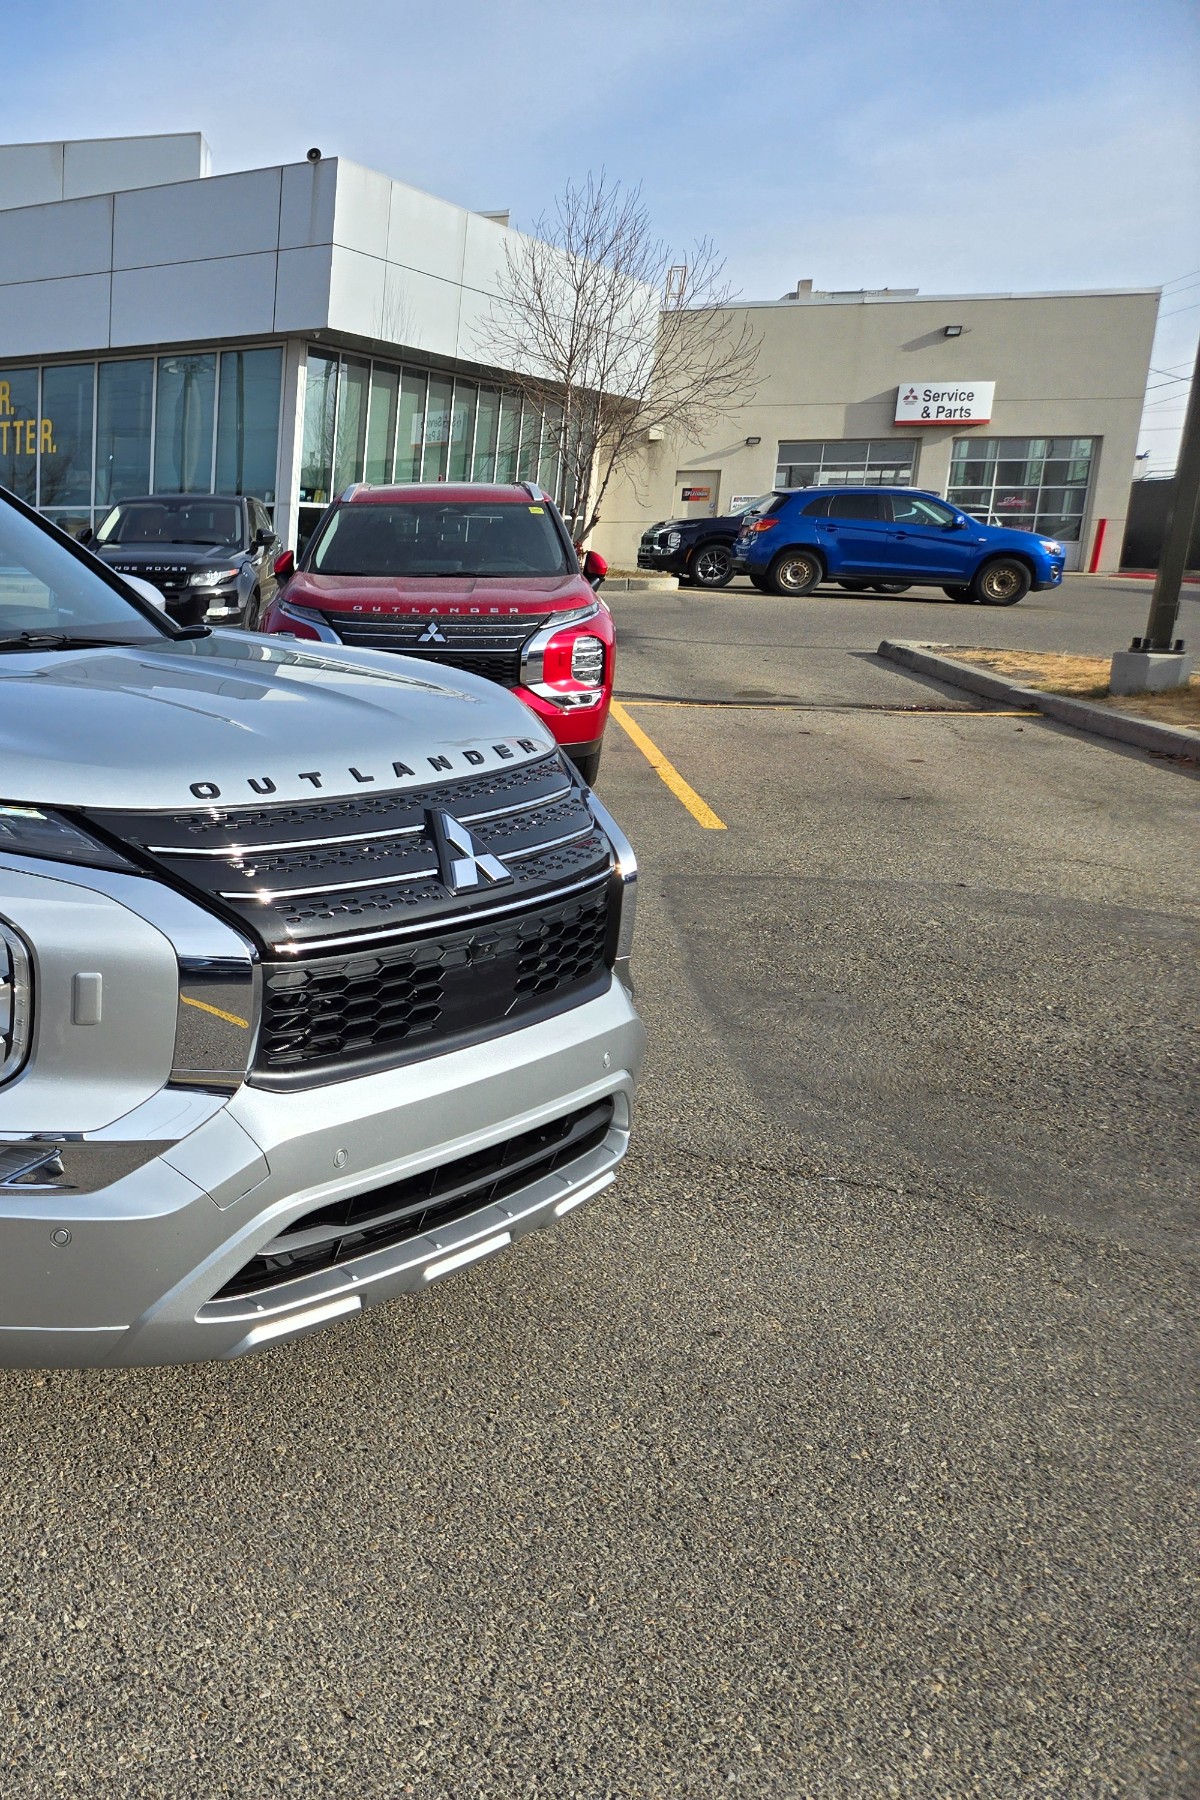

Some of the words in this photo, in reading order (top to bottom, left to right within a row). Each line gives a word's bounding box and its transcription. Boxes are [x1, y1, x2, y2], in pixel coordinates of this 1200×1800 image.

[922, 389, 975, 402] Service
[920, 406, 931, 418] &
[936, 406, 971, 418] Parts
[353, 605, 519, 613] OUTLANDER
[189, 738, 539, 800] OUTLANDER
